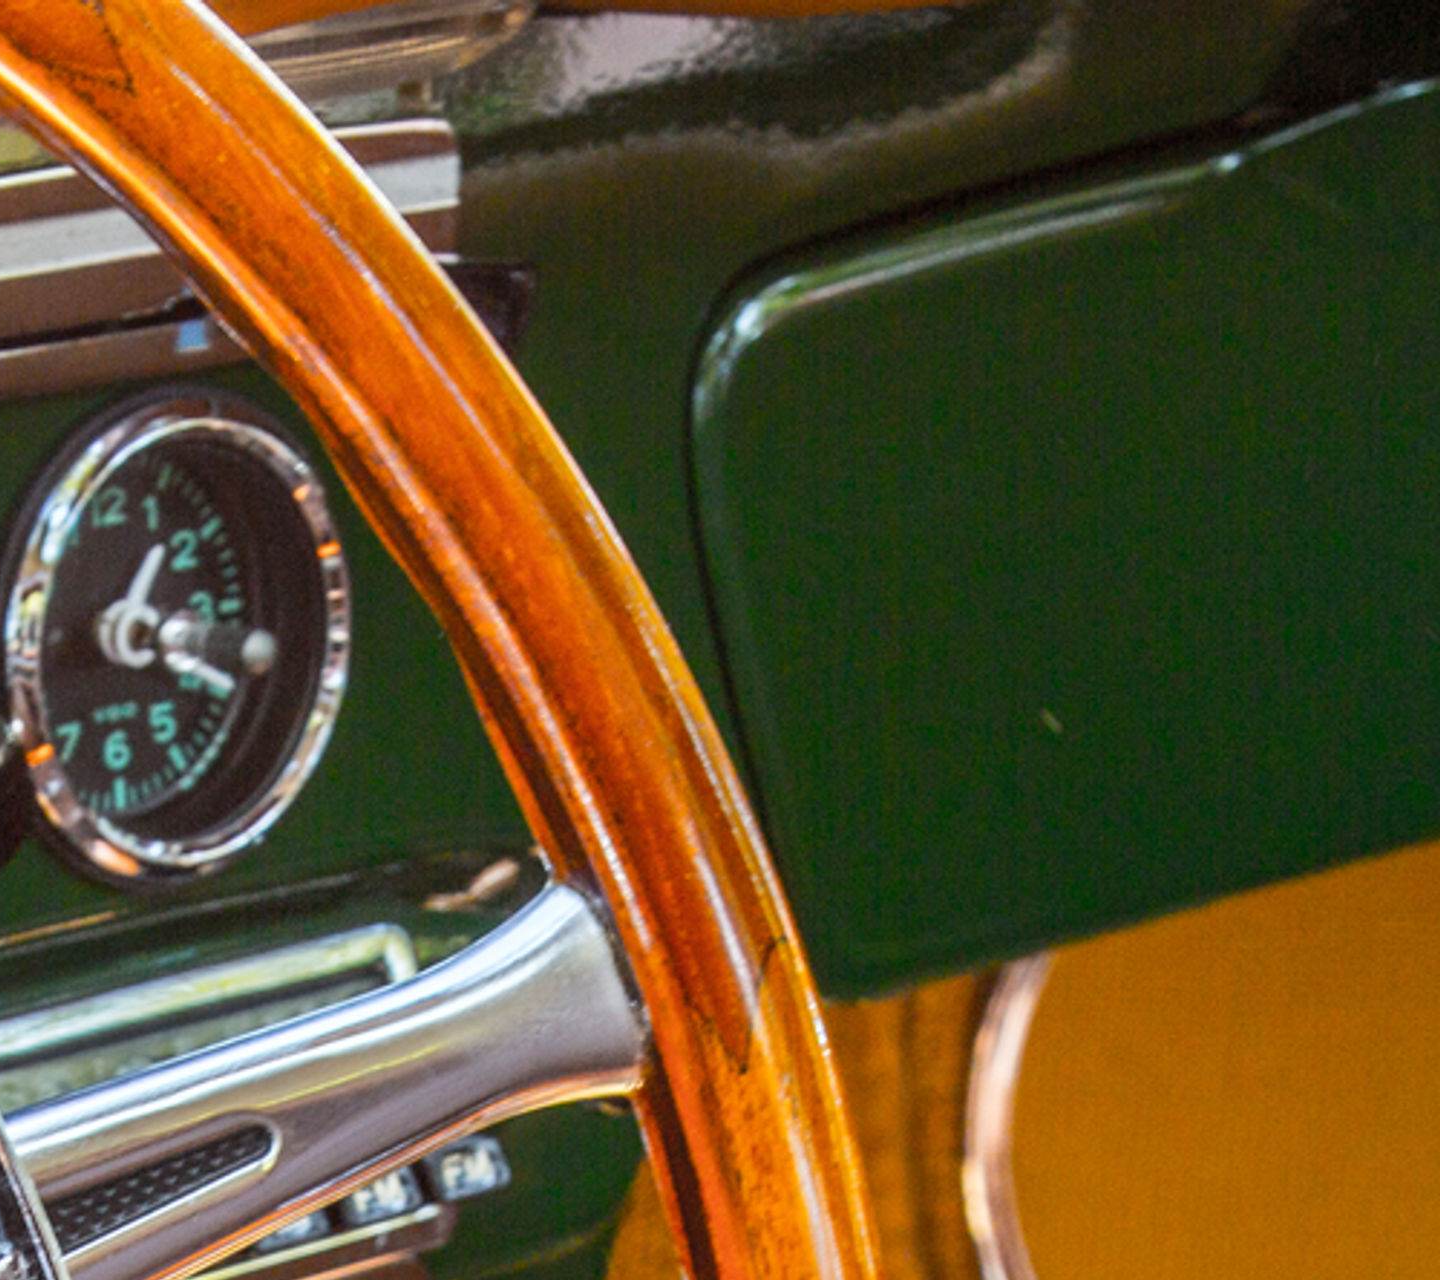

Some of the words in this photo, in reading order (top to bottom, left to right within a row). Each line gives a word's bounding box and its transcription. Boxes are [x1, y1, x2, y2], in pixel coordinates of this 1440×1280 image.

[144, 496, 159, 532] 1
[170, 528, 199, 572] 2
[56, 721, 82, 764] 7
[148, 702, 177, 743] 5
[103, 730, 132, 771] 6
